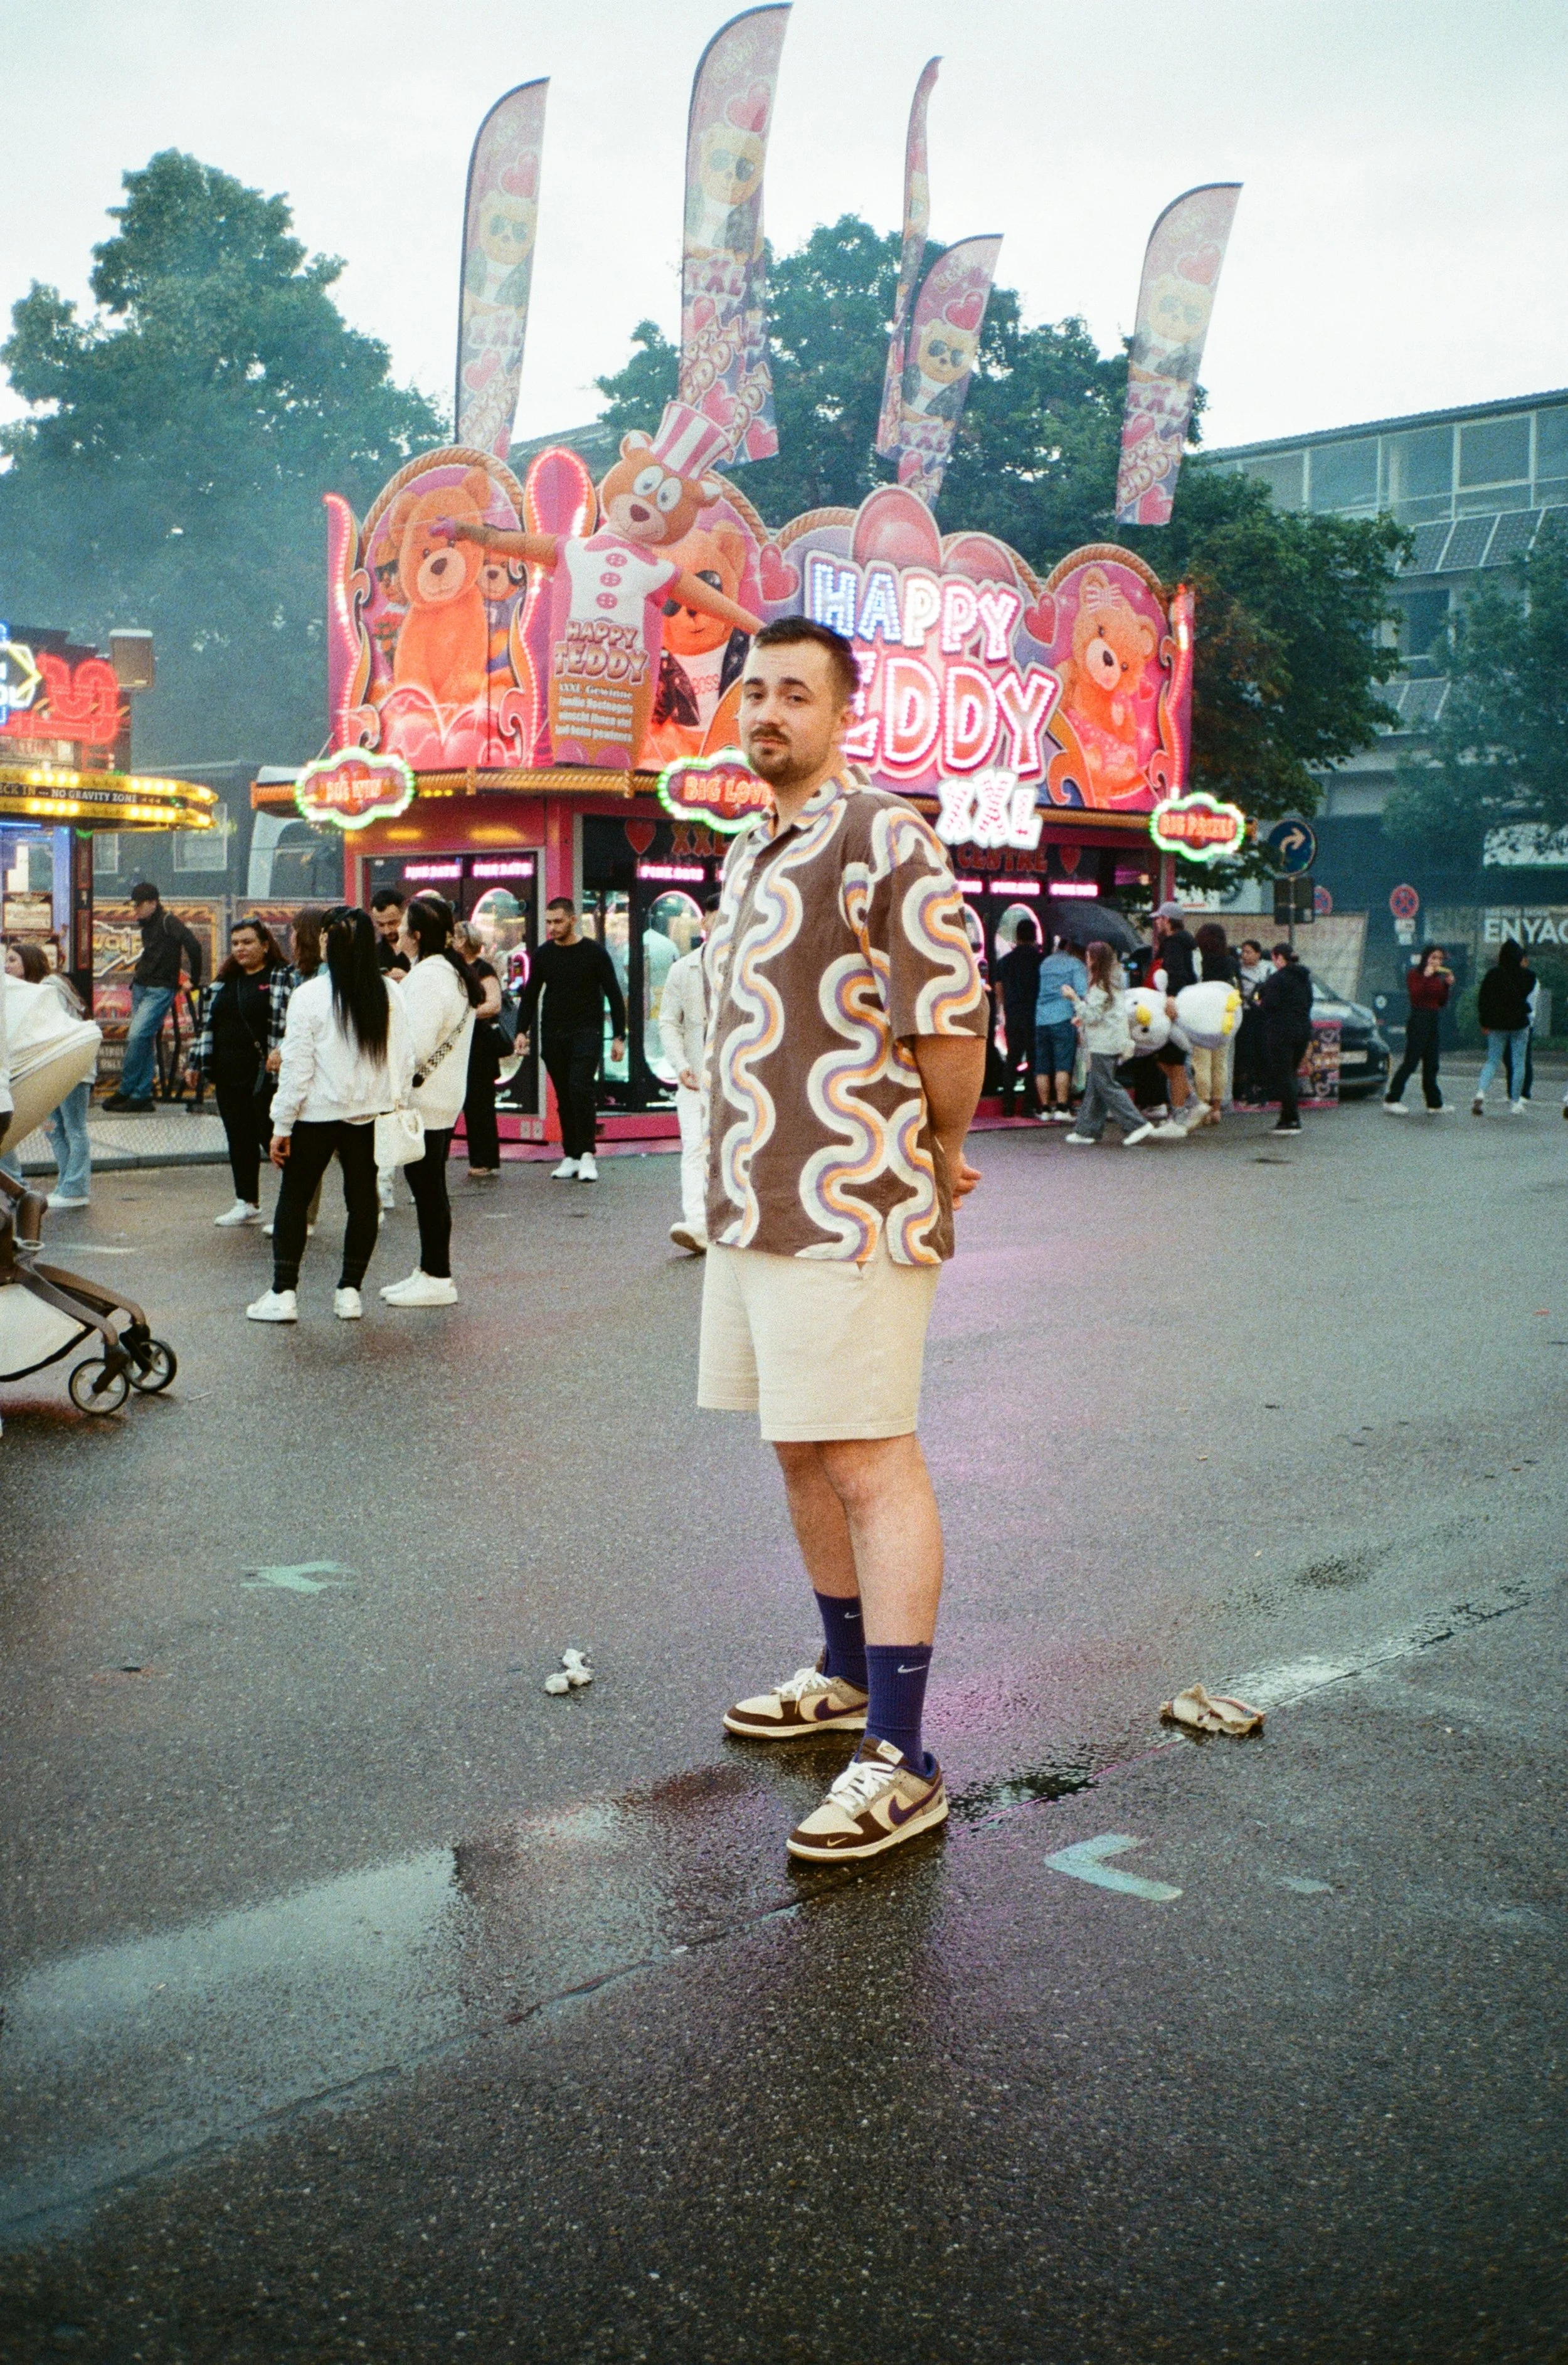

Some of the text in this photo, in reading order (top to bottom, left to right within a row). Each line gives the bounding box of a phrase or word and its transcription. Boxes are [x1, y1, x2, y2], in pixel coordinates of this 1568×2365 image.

[809, 557, 1025, 666] HAPPY
[566, 618, 638, 650] HAPPY
[555, 642, 649, 684] TEDDY
[840, 650, 1061, 780] EDDY
[51, 788, 66, 799] NO
[68, 789, 110, 802] GRAVITY
[112, 791, 137, 803] ZONE
[684, 775, 721, 803] BIG
[937, 770, 1042, 848] XXL
[956, 845, 1048, 874] CENTRE
